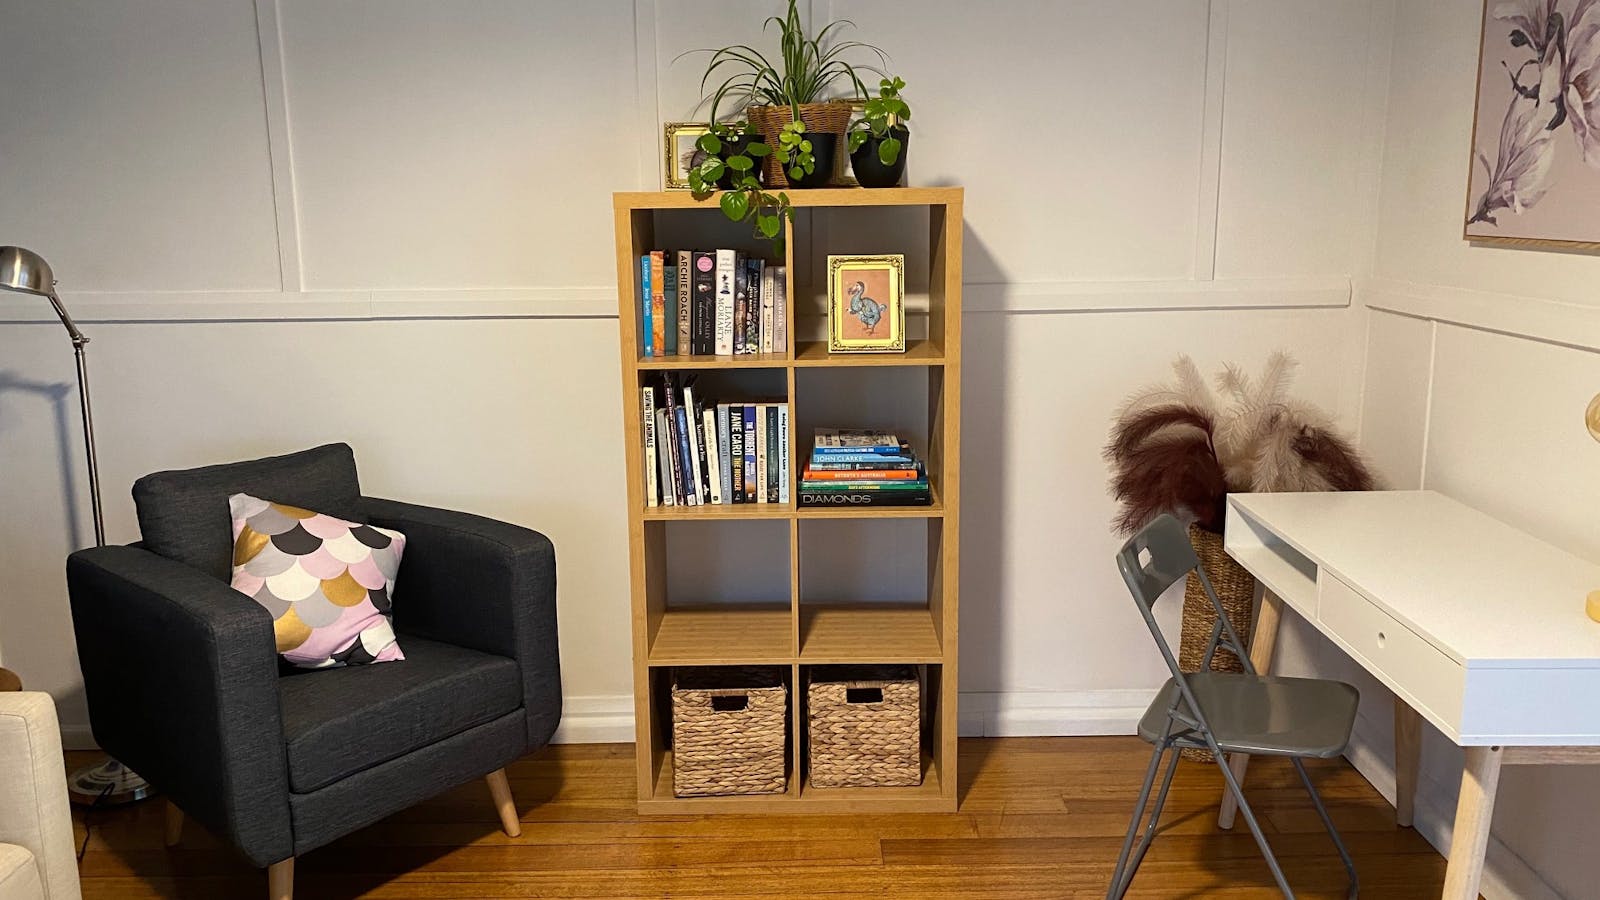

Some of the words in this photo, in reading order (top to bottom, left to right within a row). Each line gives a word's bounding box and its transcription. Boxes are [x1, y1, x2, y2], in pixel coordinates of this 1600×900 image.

[731, 412, 742, 432] JANE
[732, 434, 742, 455] CARO
[745, 430, 755, 456] TORRENT
[803, 495, 871, 503] DIAMONDS
